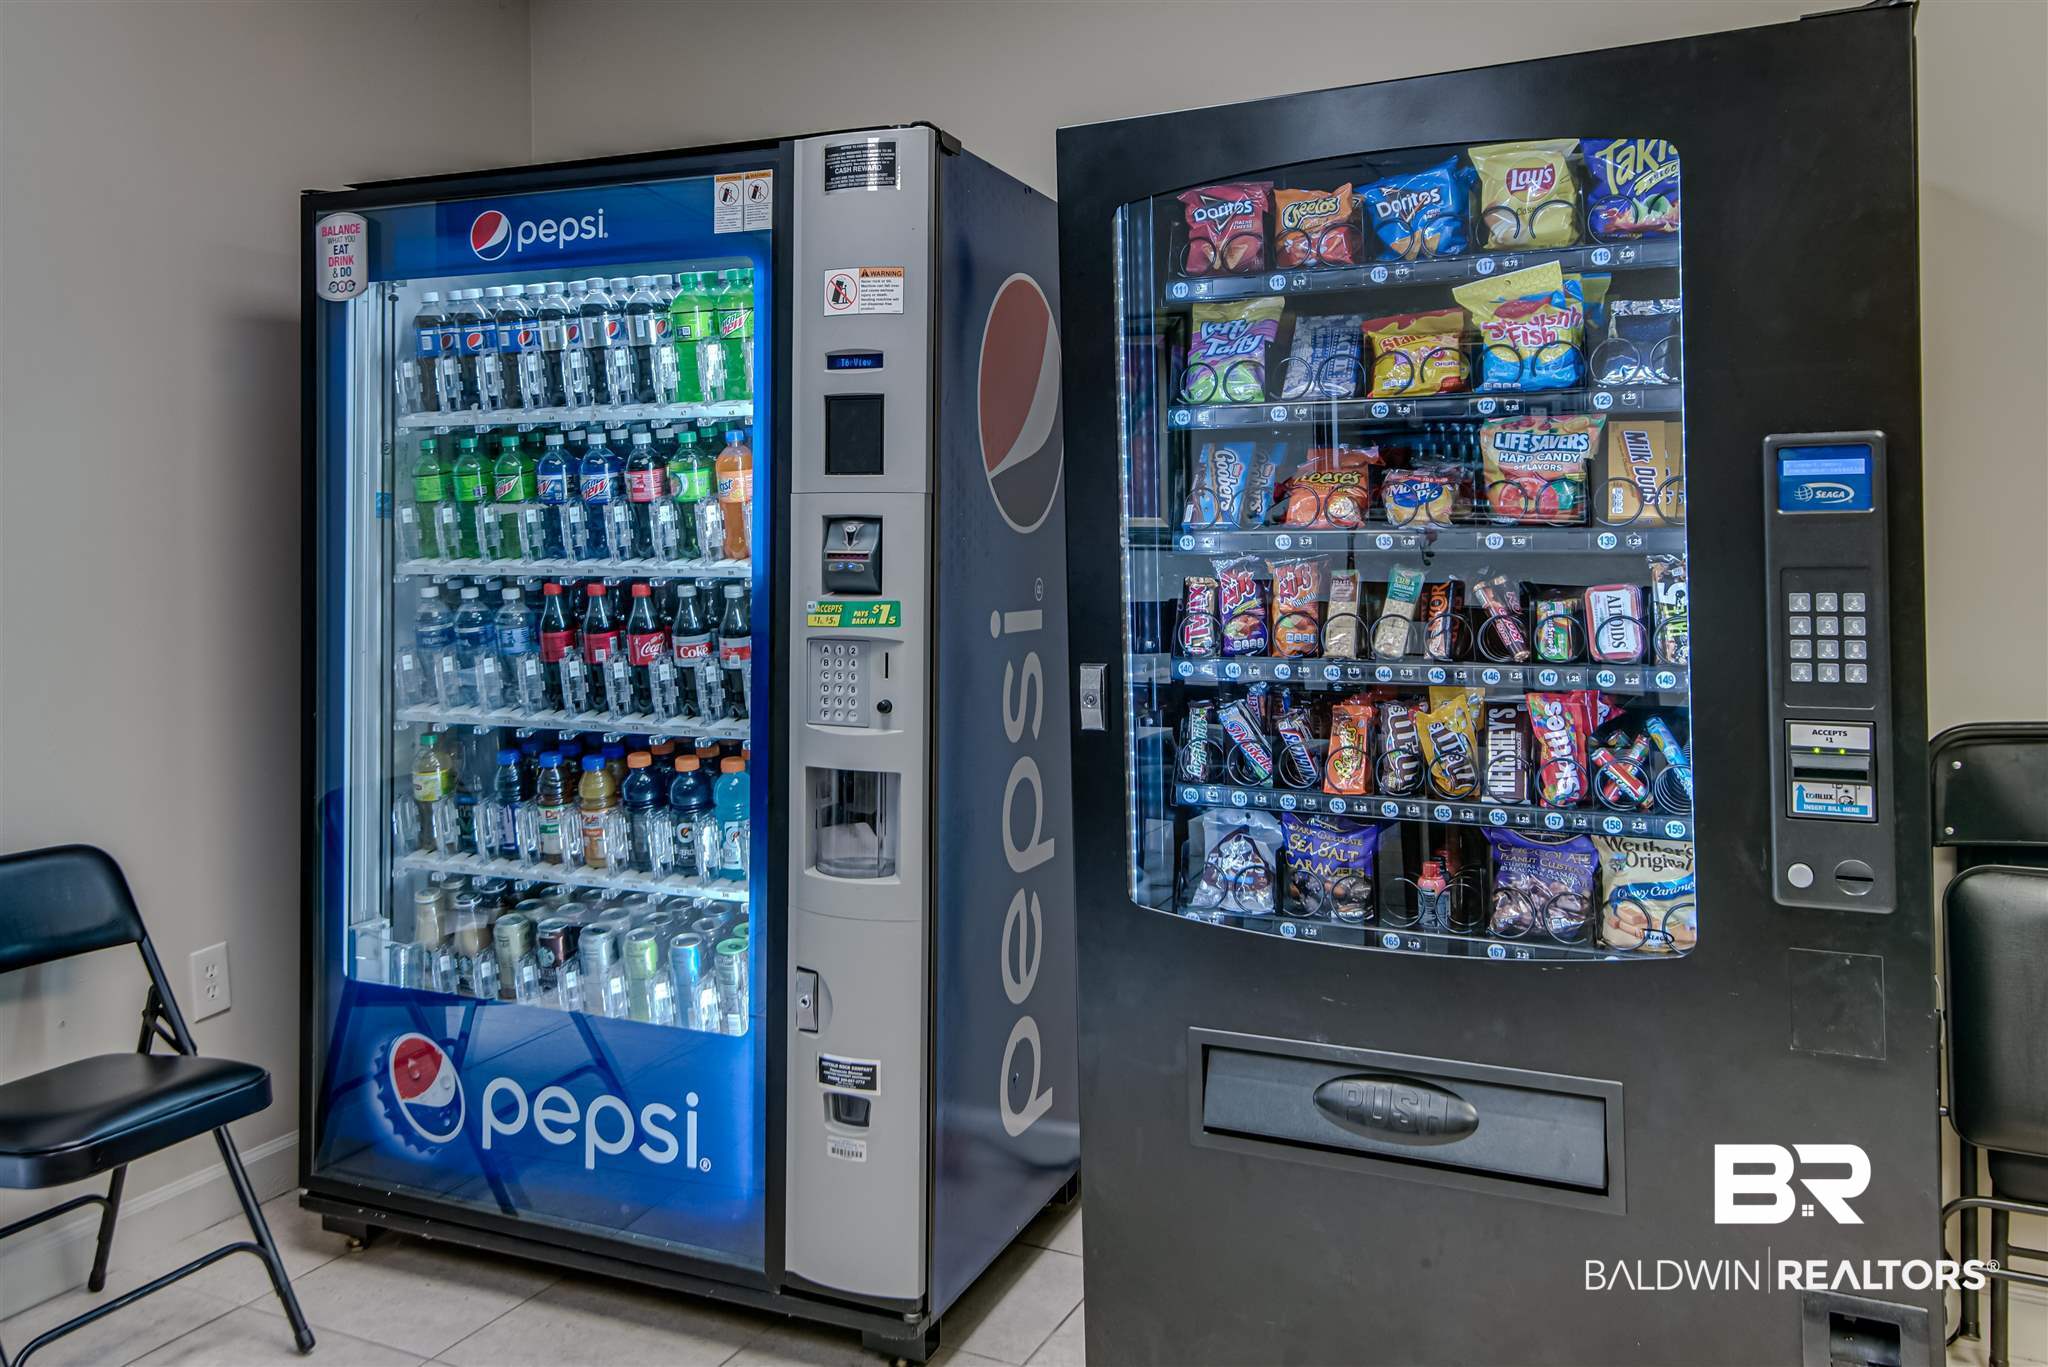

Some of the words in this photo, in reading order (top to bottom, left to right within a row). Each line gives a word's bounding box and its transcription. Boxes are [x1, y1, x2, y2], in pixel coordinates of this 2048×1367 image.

[834, 165, 852, 175] CASH
[852, 163, 882, 173] REWARD
[1595, 138, 1679, 195] Taki
[1510, 164, 1554, 192] Lay's
[1376, 187, 1441, 218] Doritos
[1192, 199, 1253, 222] Doritos
[321, 223, 361, 238] BALANCE
[517, 208, 605, 253] pepsi
[327, 236, 343, 245] WHAT
[344, 234, 356, 243] YOU
[333, 243, 349, 255] EAT
[328, 255, 354, 267] DRINK
[1592, 250, 1610, 263] 119
[340, 266, 352, 277] DO
[1476, 259, 1494, 272] 117
[869, 270, 903, 278] WARNING
[1371, 269, 1387, 280] 115
[1270, 276, 1285, 288] 113
[1173, 284, 1188, 296] 111
[1504, 324, 1558, 352] Fish
[1204, 333, 1264, 357] Taffy
[1478, 400, 1496, 412] 127
[1594, 394, 1613, 407] 129
[1271, 407, 1287, 420] 123
[1372, 403, 1388, 416] 125
[1494, 431, 1529, 450] LIFE
[1528, 432, 1590, 452] SAVERS
[1622, 430, 1653, 464] Milk
[1499, 451, 1533, 464] HARD
[1537, 451, 1580, 463] CANDY
[1214, 449, 1238, 512] Goobers
[1814, 489, 1845, 499] SEAGA
[1180, 536, 1195, 549] 131
[1376, 535, 1392, 547] 135
[1486, 535, 1503, 547] 137
[1598, 535, 1616, 547] 139
[816, 604, 843, 613] ACCEPTS
[851, 617, 867, 625] BACK
[868, 617, 876, 625] IN
[1606, 594, 1628, 650] ALTOIDS
[680, 645, 709, 659] Coke
[1227, 664, 1241, 676] 141
[1275, 665, 1290, 677] 142
[1324, 667, 1339, 678] 143
[1375, 668, 1391, 679] 144
[1429, 670, 1445, 681] 145
[1483, 670, 1499, 682] 146
[1540, 672, 1557, 683] 147
[1597, 672, 1615, 684] 148
[1656, 674, 1675, 686] 149
[1811, 728, 1848, 737] ACCEPTS
[1825, 736, 1834, 744] $1
[1233, 729, 1273, 775] Musketee
[1488, 707, 1518, 793] HERSHEY'S
[1543, 699, 1582, 801] Skittles
[1184, 791, 1198, 801] 150
[1232, 794, 1247, 804] 151
[1280, 797, 1296, 808] 152
[1330, 800, 1346, 811] 153
[1803, 803, 1826, 812] INSERT
[1827, 804, 1841, 813] BILL
[1842, 806, 1860, 814] HERE
[1382, 803, 1397, 815] 154
[1435, 807, 1451, 818] 155
[1490, 811, 1506, 822] 156
[1546, 814, 1562, 826] 157
[1604, 818, 1622, 831] 158
[1631, 822, 1647, 831] 2.25
[1666, 823, 1684, 836] 159
[1287, 832, 1315, 856] SEA
[1317, 841, 1360, 863] SALT
[1599, 835, 1694, 857] Werther's
[1285, 849, 1366, 878] CARAMELS
[1625, 850, 1693, 873] Original
[990, 608, 1055, 1138] pepsi
[1650, 881, 1695, 897] Carame
[1281, 925, 1296, 936] 163
[1384, 935, 1399, 947] 165
[1489, 946, 1505, 957] 167
[1342, 1081, 1449, 1137] PUSH
[481, 1076, 700, 1171] pepsi
